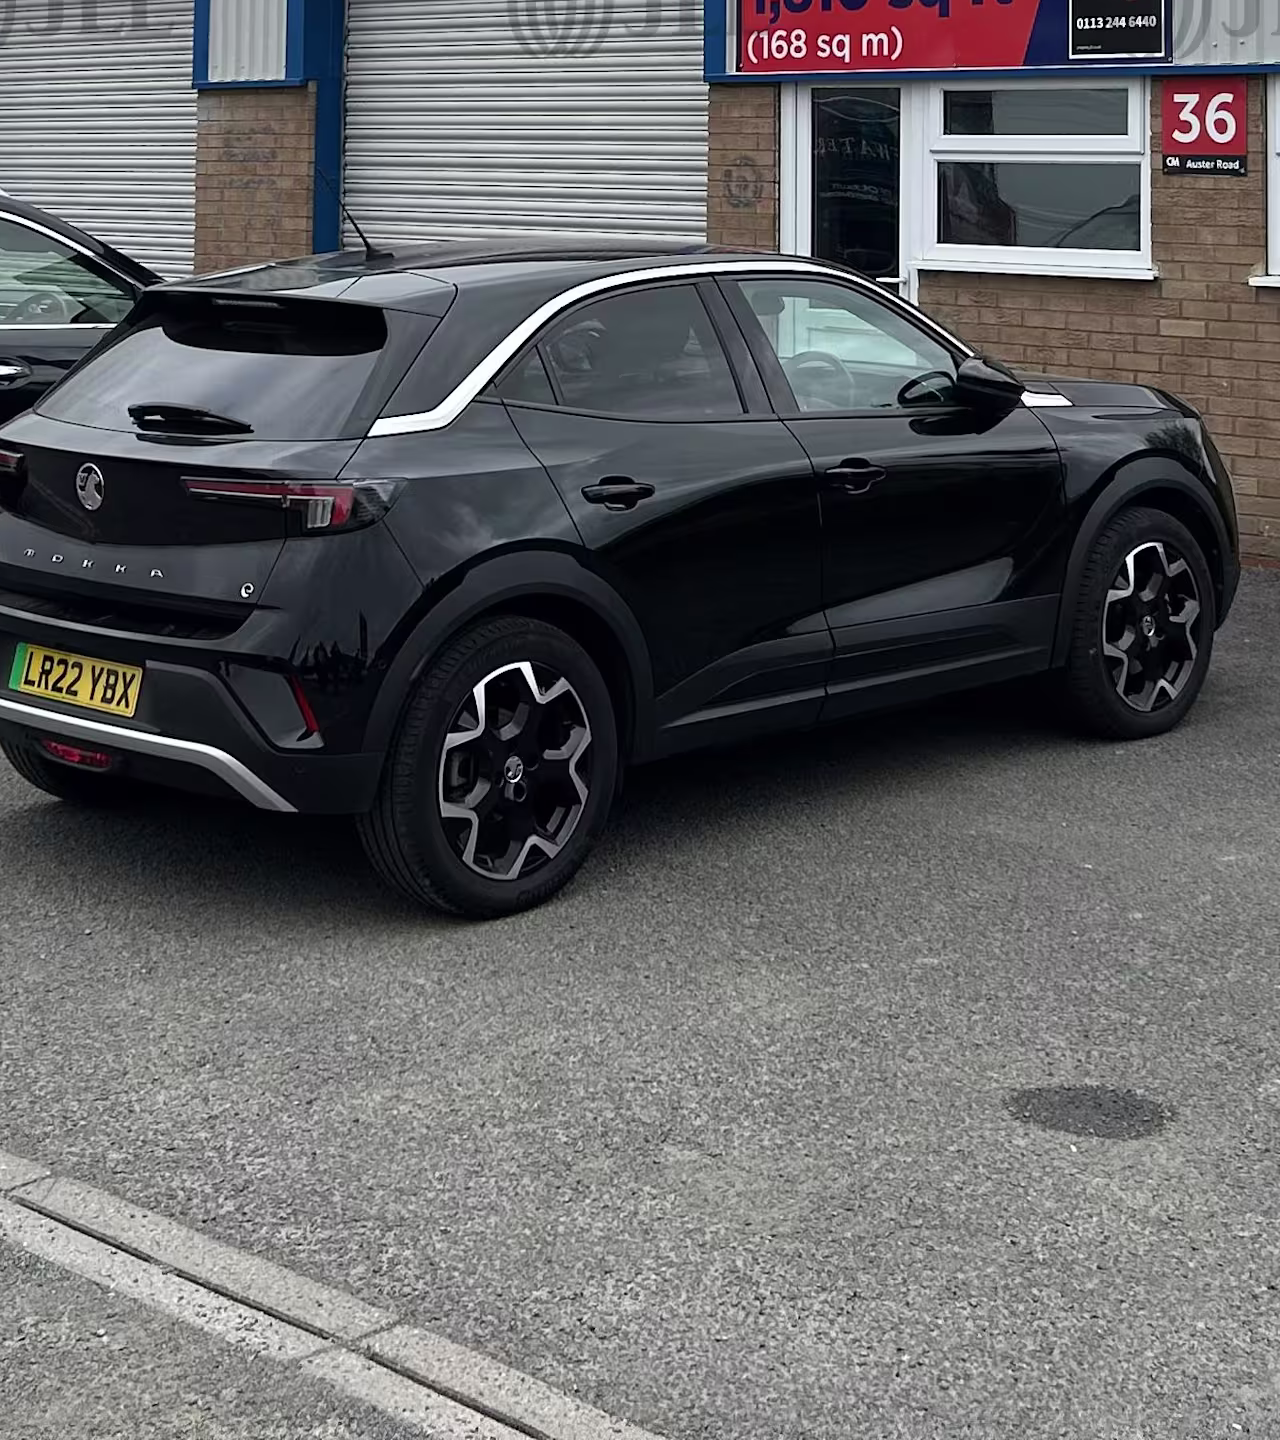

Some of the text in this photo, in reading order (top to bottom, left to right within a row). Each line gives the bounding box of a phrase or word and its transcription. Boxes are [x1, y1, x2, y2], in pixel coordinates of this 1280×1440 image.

[1076, 15, 1157, 29] 0113 244 6440
[747, 26, 903, 63] (168 sq m)
[1171, 93, 1237, 144] 36
[1186, 159, 1215, 169] Auster
[1216, 160, 1240, 169] Road
[23, 651, 136, 709] LR22 YBX
